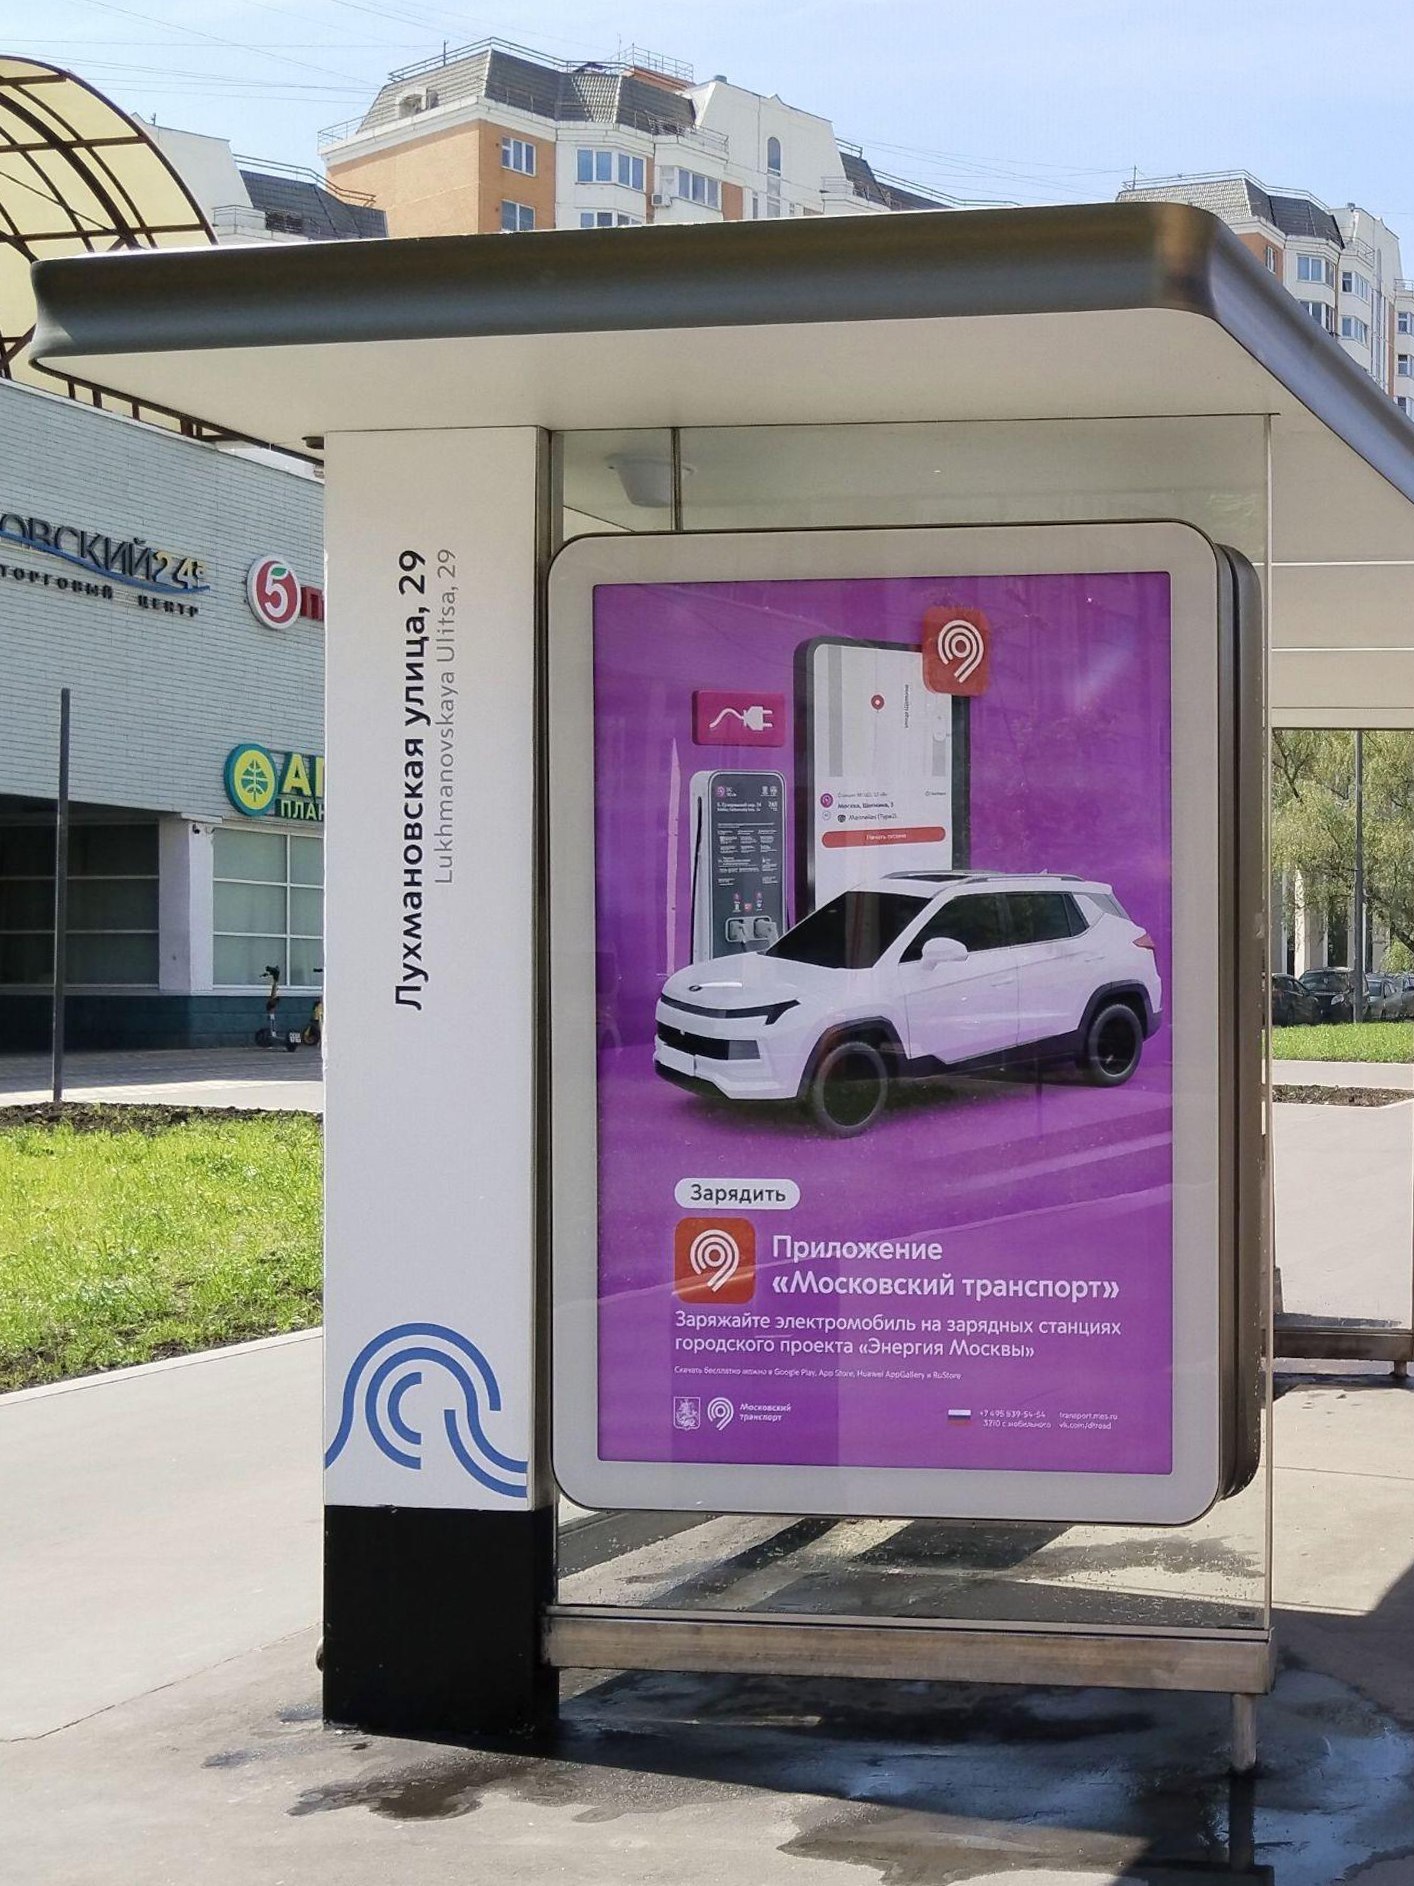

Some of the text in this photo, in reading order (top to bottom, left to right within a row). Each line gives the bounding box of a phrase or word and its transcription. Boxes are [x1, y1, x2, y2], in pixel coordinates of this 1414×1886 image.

[264, 564, 289, 618] 5
[138, 594, 199, 618] ЦЕНТР
[434, 549, 459, 884] Lukhmanovskaya Ulitsa, 29
[394, 550, 431, 1011] Лухмановская улица, 29
[690, 1184, 786, 1205] Зарядить
[772, 1234, 943, 1263] Приложение
[772, 1270, 1120, 1303] «Московский транспорт»
[674, 1310, 1122, 1337] Заряжайте электромобиль на зарядных станциях
[674, 1336, 1036, 1358] городского проекта «Энергия Москвы»
[774, 1367, 800, 1377] Google
[819, 1369, 834, 1378] App
[857, 1369, 884, 1378] Huawei
[885, 1370, 925, 1380] AppGallery
[932, 1371, 961, 1380] RuStore
[739, 1402, 792, 1412] Московский
[739, 1414, 782, 1422] транспорт
